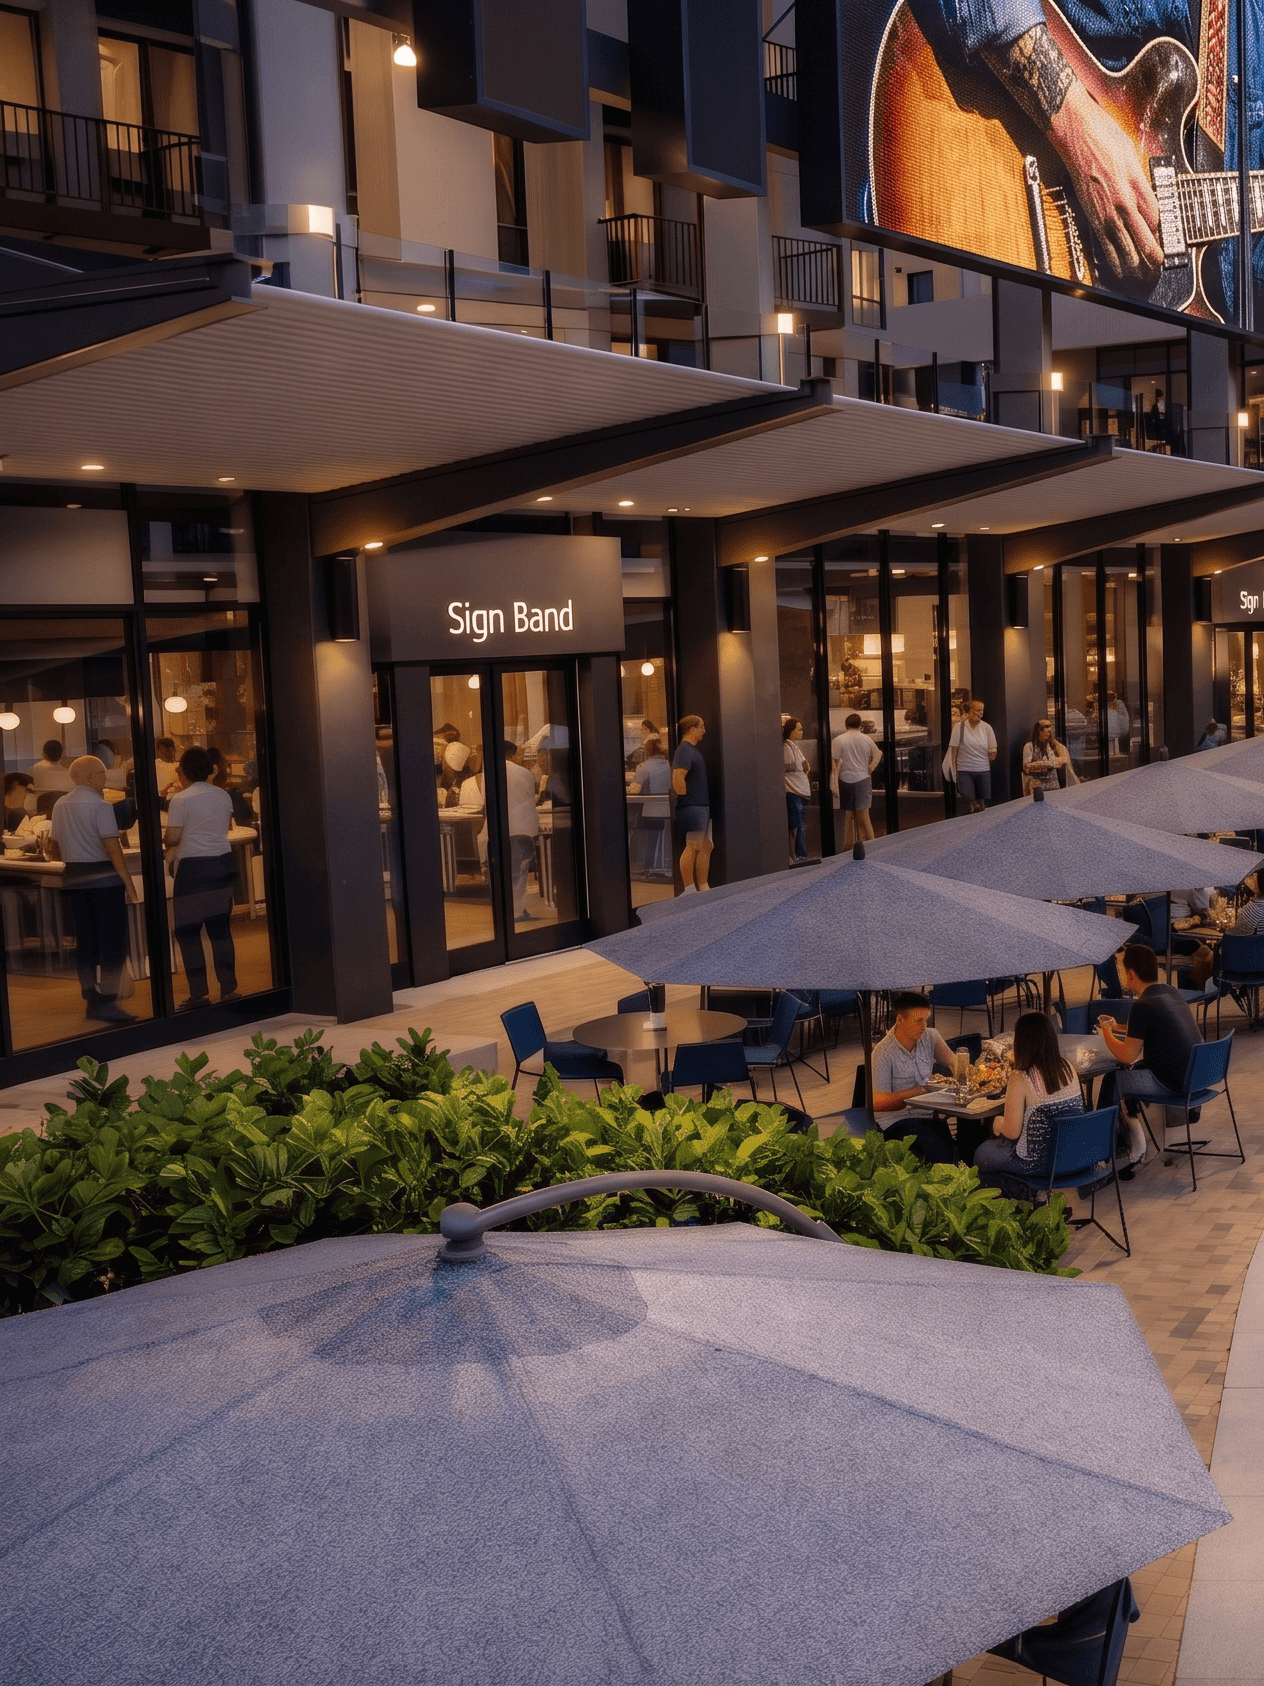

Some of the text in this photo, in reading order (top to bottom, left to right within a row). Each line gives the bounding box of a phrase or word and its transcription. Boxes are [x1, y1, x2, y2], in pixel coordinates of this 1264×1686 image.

[1239, 590, 1259, 614] Sgn
[447, 599, 573, 643] Sign Band
